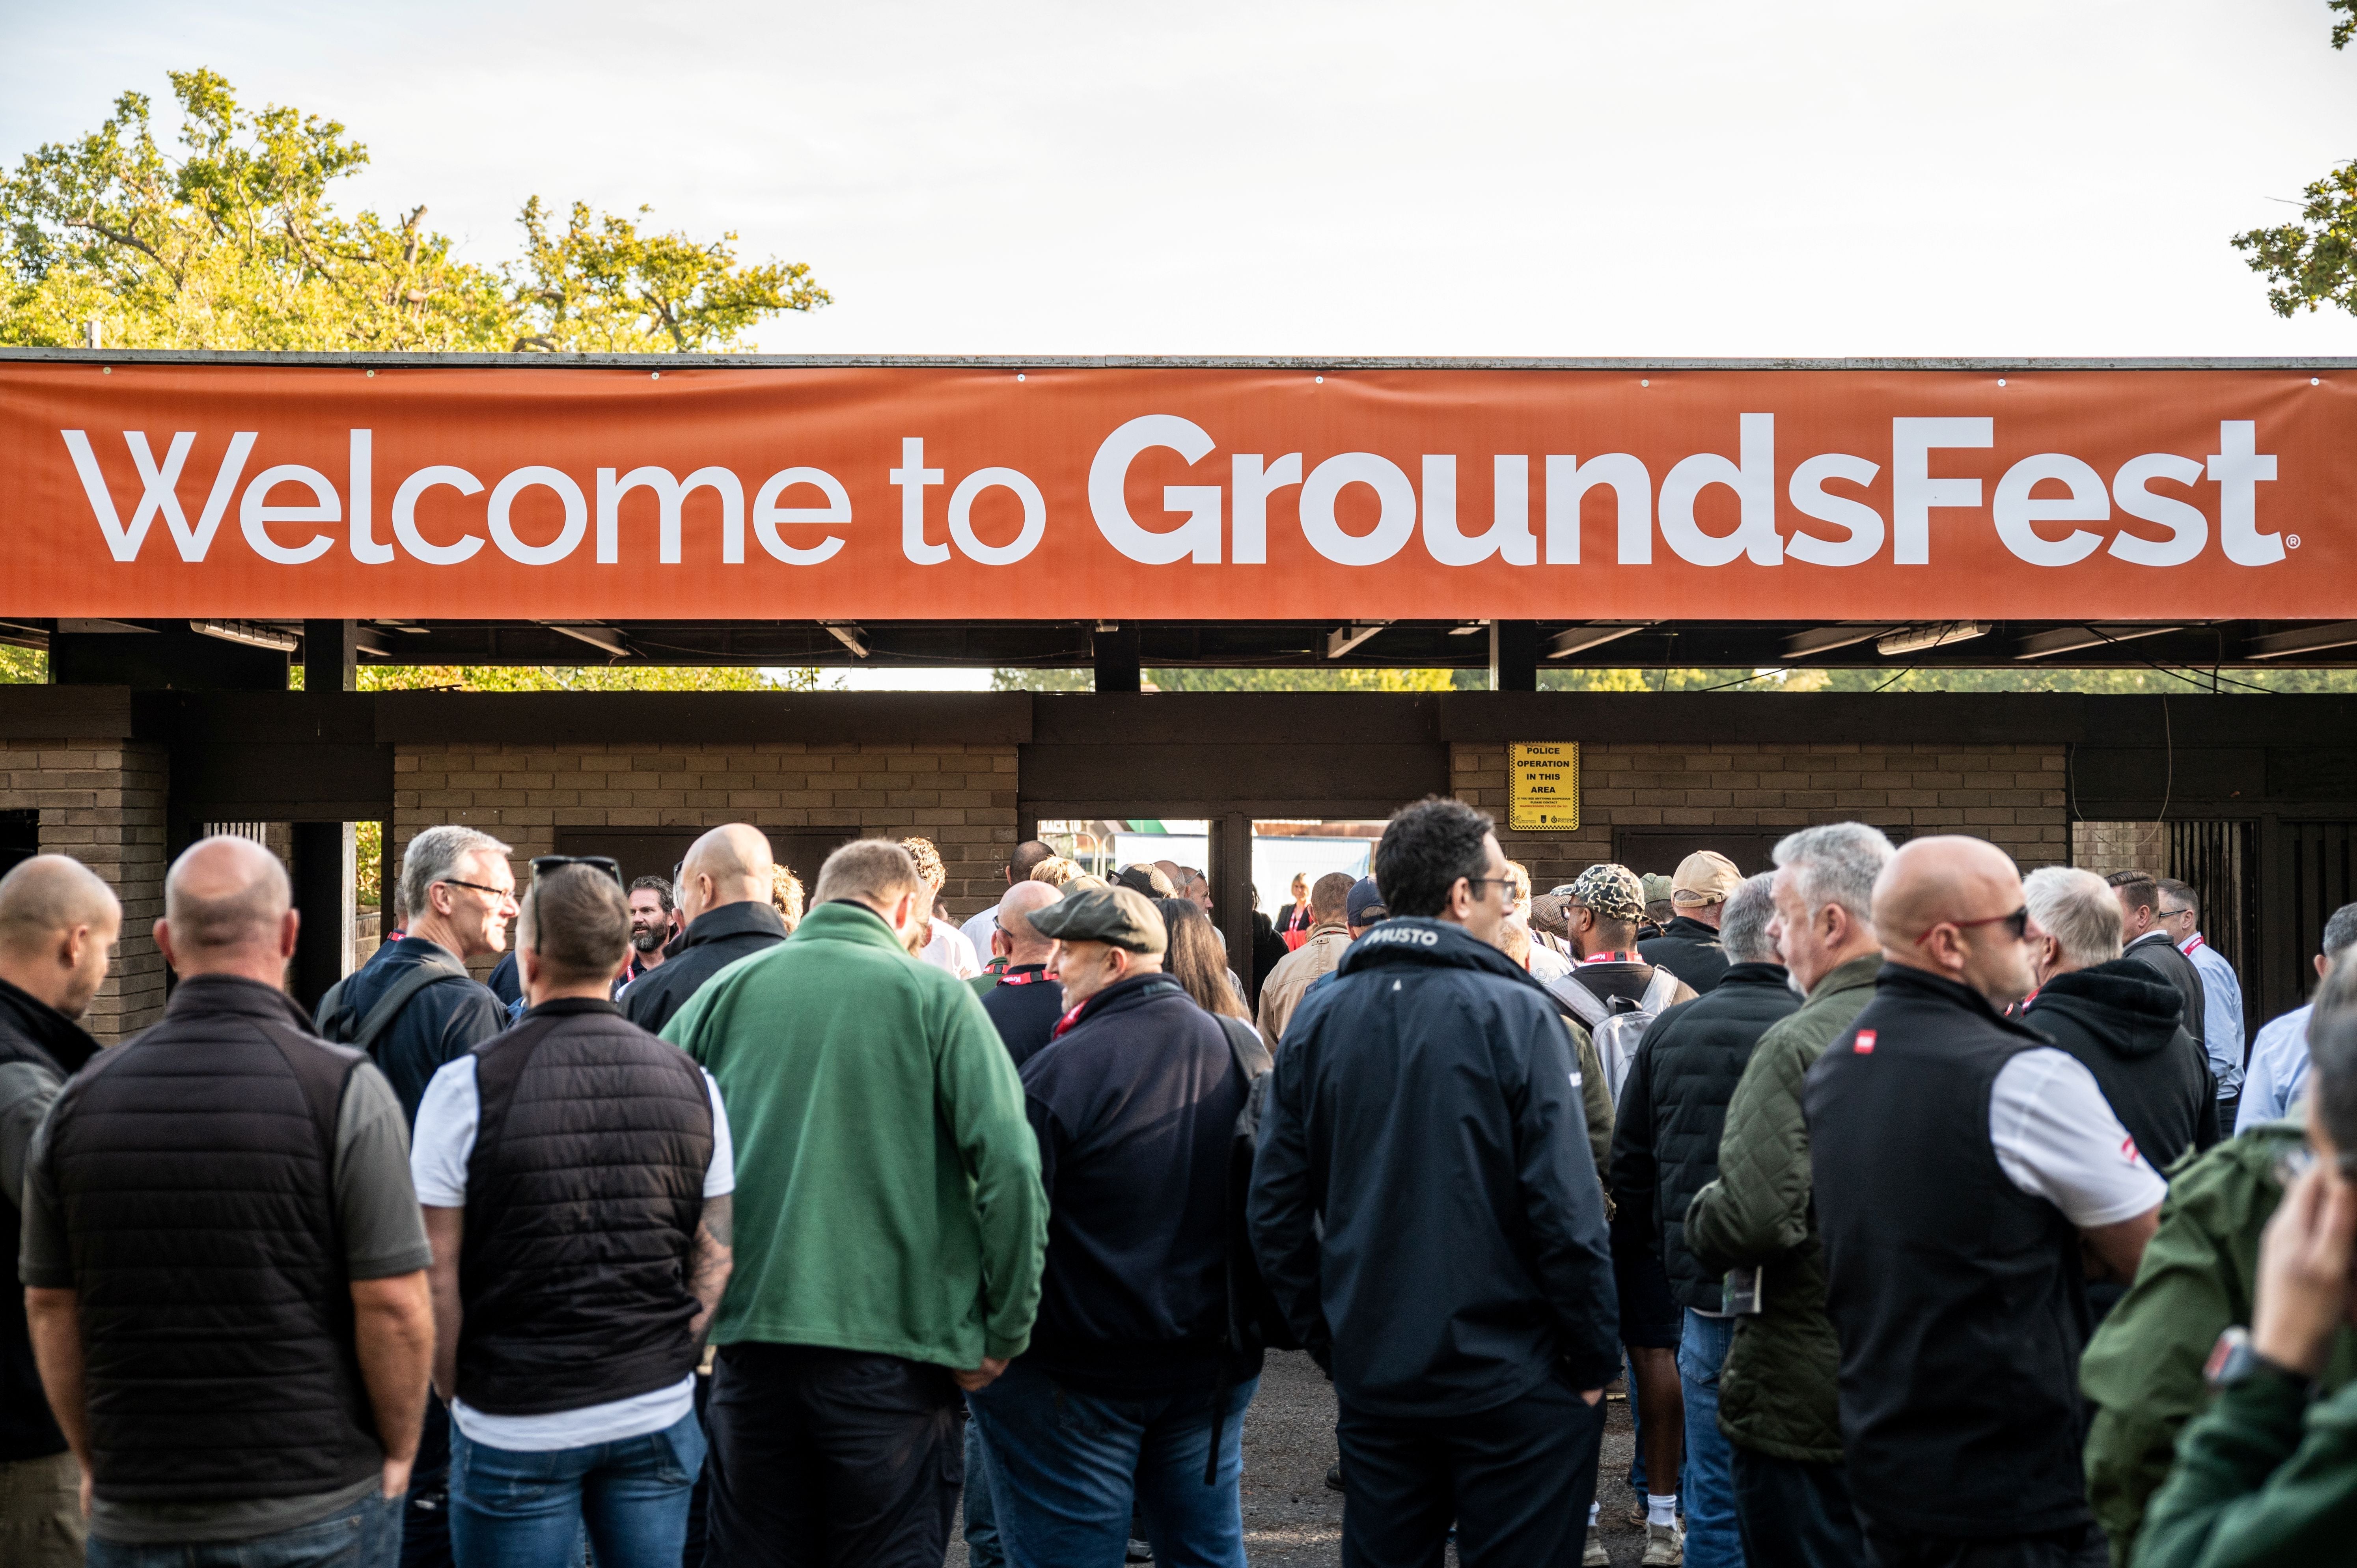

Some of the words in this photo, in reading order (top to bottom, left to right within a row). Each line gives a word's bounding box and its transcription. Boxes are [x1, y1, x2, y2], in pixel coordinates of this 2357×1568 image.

[61, 429, 852, 566] Welcome
[890, 437, 1046, 566] to
[1364, 927, 1438, 946] MUSTO
